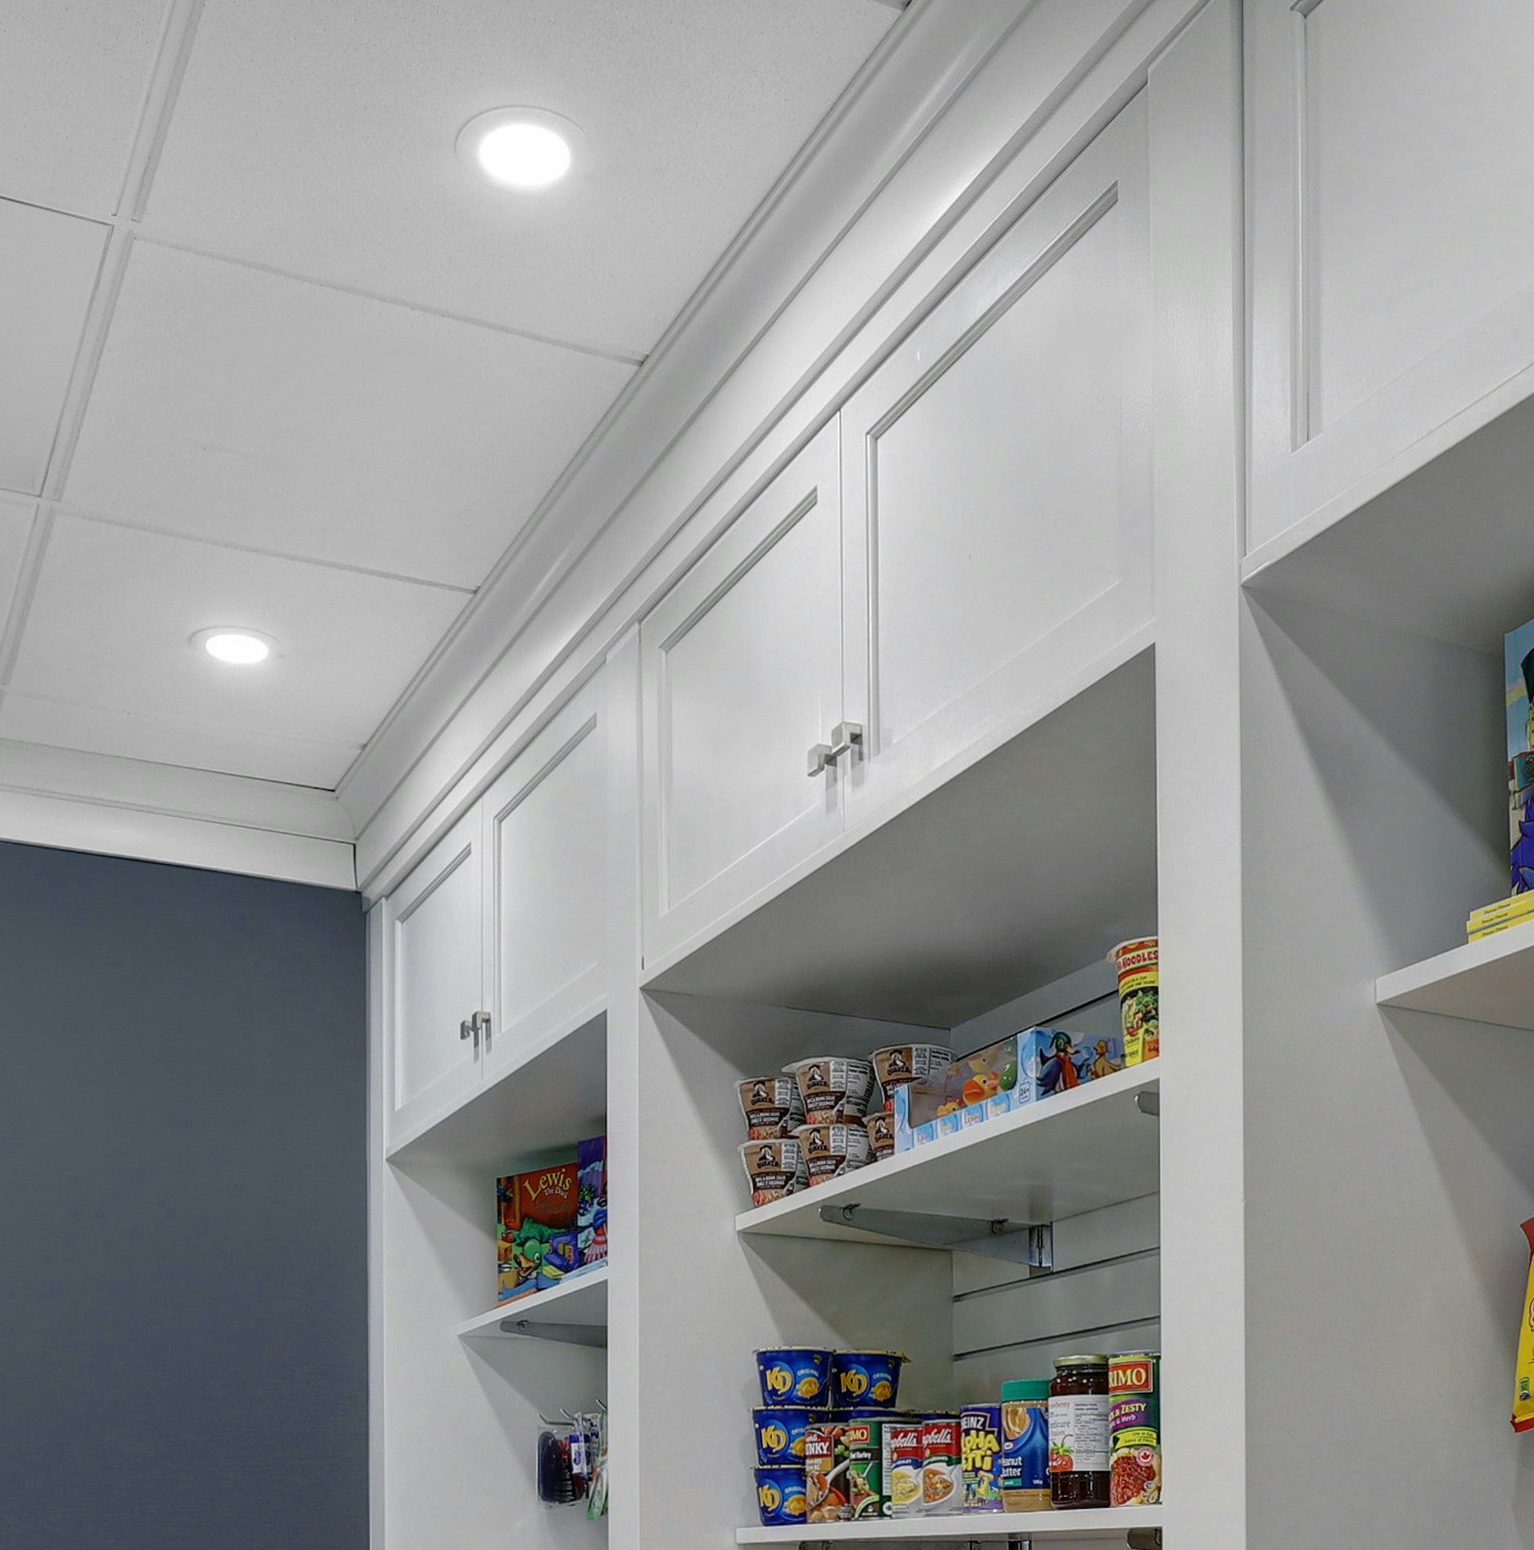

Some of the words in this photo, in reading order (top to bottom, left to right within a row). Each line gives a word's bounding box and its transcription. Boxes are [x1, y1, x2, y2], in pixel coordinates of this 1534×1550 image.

[523, 1168, 572, 1201] Lewis
[544, 1187, 554, 1197] The
[766, 1366, 794, 1396] KD
[840, 1370, 868, 1397] KD
[1109, 1367, 1147, 1388] RIMO
[1121, 1415, 1136, 1424] Herb
[1122, 1403, 1147, 1414] ZESTY
[962, 1416, 985, 1430] EINZ
[761, 1425, 787, 1453] KD
[759, 1484, 781, 1511] KD
